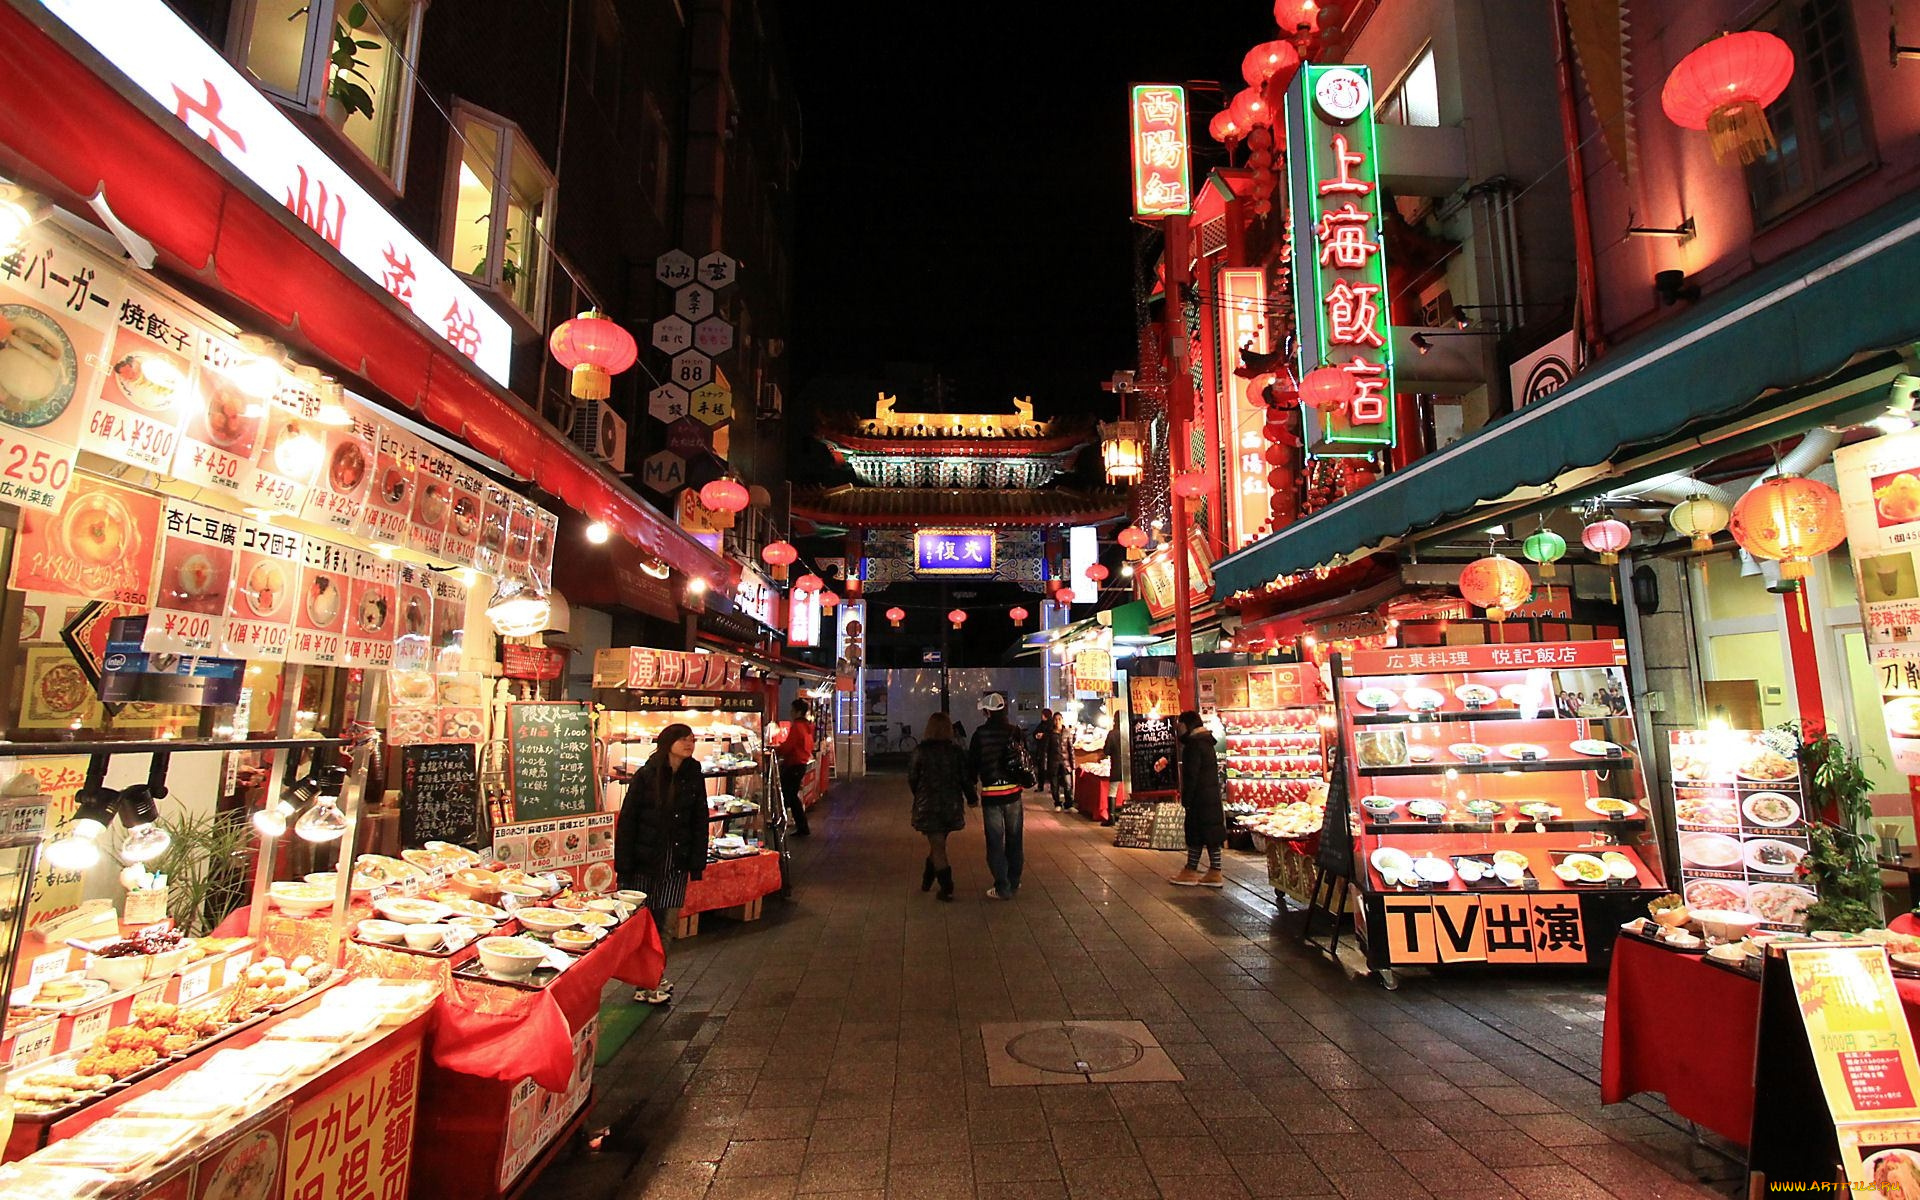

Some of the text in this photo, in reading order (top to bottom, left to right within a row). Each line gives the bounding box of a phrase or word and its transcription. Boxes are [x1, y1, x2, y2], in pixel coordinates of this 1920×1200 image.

[1319, 133, 1385, 426] 上海飯店
[120, 298, 192, 351] 焼餃子
[680, 366, 702, 382] 88
[194, 447, 237, 478] ¥450
[0, 481, 56, 507] 広州菜館
[255, 473, 295, 501] ¥450
[167, 508, 237, 546] 杏仁豆腐
[243, 527, 297, 558] ゴマ団子
[436, 580, 466, 601] 桃まん
[165, 614, 210, 638] ¥200
[1386, 647, 1577, 669] 広東料理 悦記飯店
[1877, 649, 1899, 659] 正宗
[1077, 679, 1109, 691] ¥300
[1386, 903, 1584, 953] TV出演
[294, 1048, 418, 1181] フカヒレ麺
